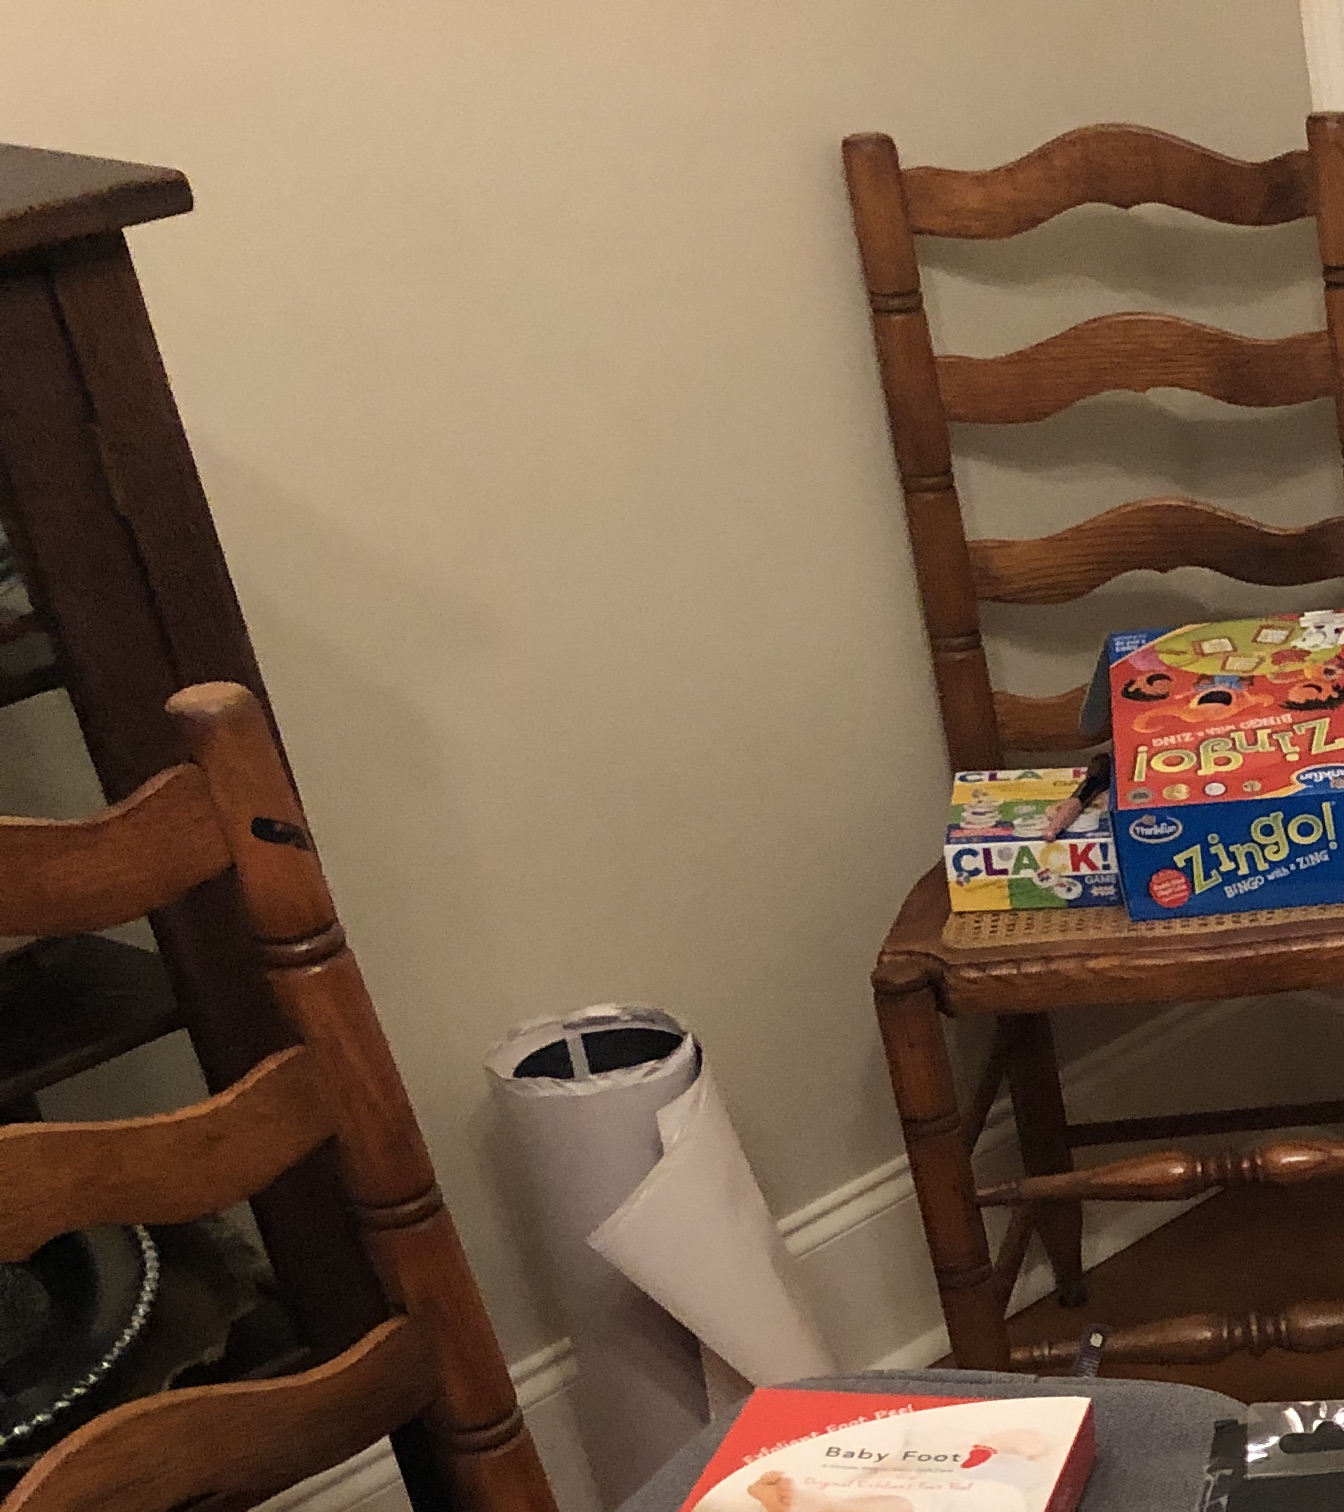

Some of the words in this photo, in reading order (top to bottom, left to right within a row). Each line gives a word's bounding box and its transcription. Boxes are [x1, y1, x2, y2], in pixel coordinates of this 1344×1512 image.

[1240, 713, 1292, 728] BINGO
[1151, 731, 1195, 747] ZING
[952, 843, 1111, 877] CLACK!
[1173, 802, 1338, 894] Zingo!
[1223, 875, 1265, 898] BINGO
[1267, 866, 1290, 881] with
[1296, 849, 1330, 870] ZING
[743, 1431, 821, 1465] Exfoliant
[826, 1416, 866, 1434] Foot
[874, 1404, 914, 1420] Peel
[825, 1446, 889, 1463] Baby
[902, 1451, 963, 1463] Foot
